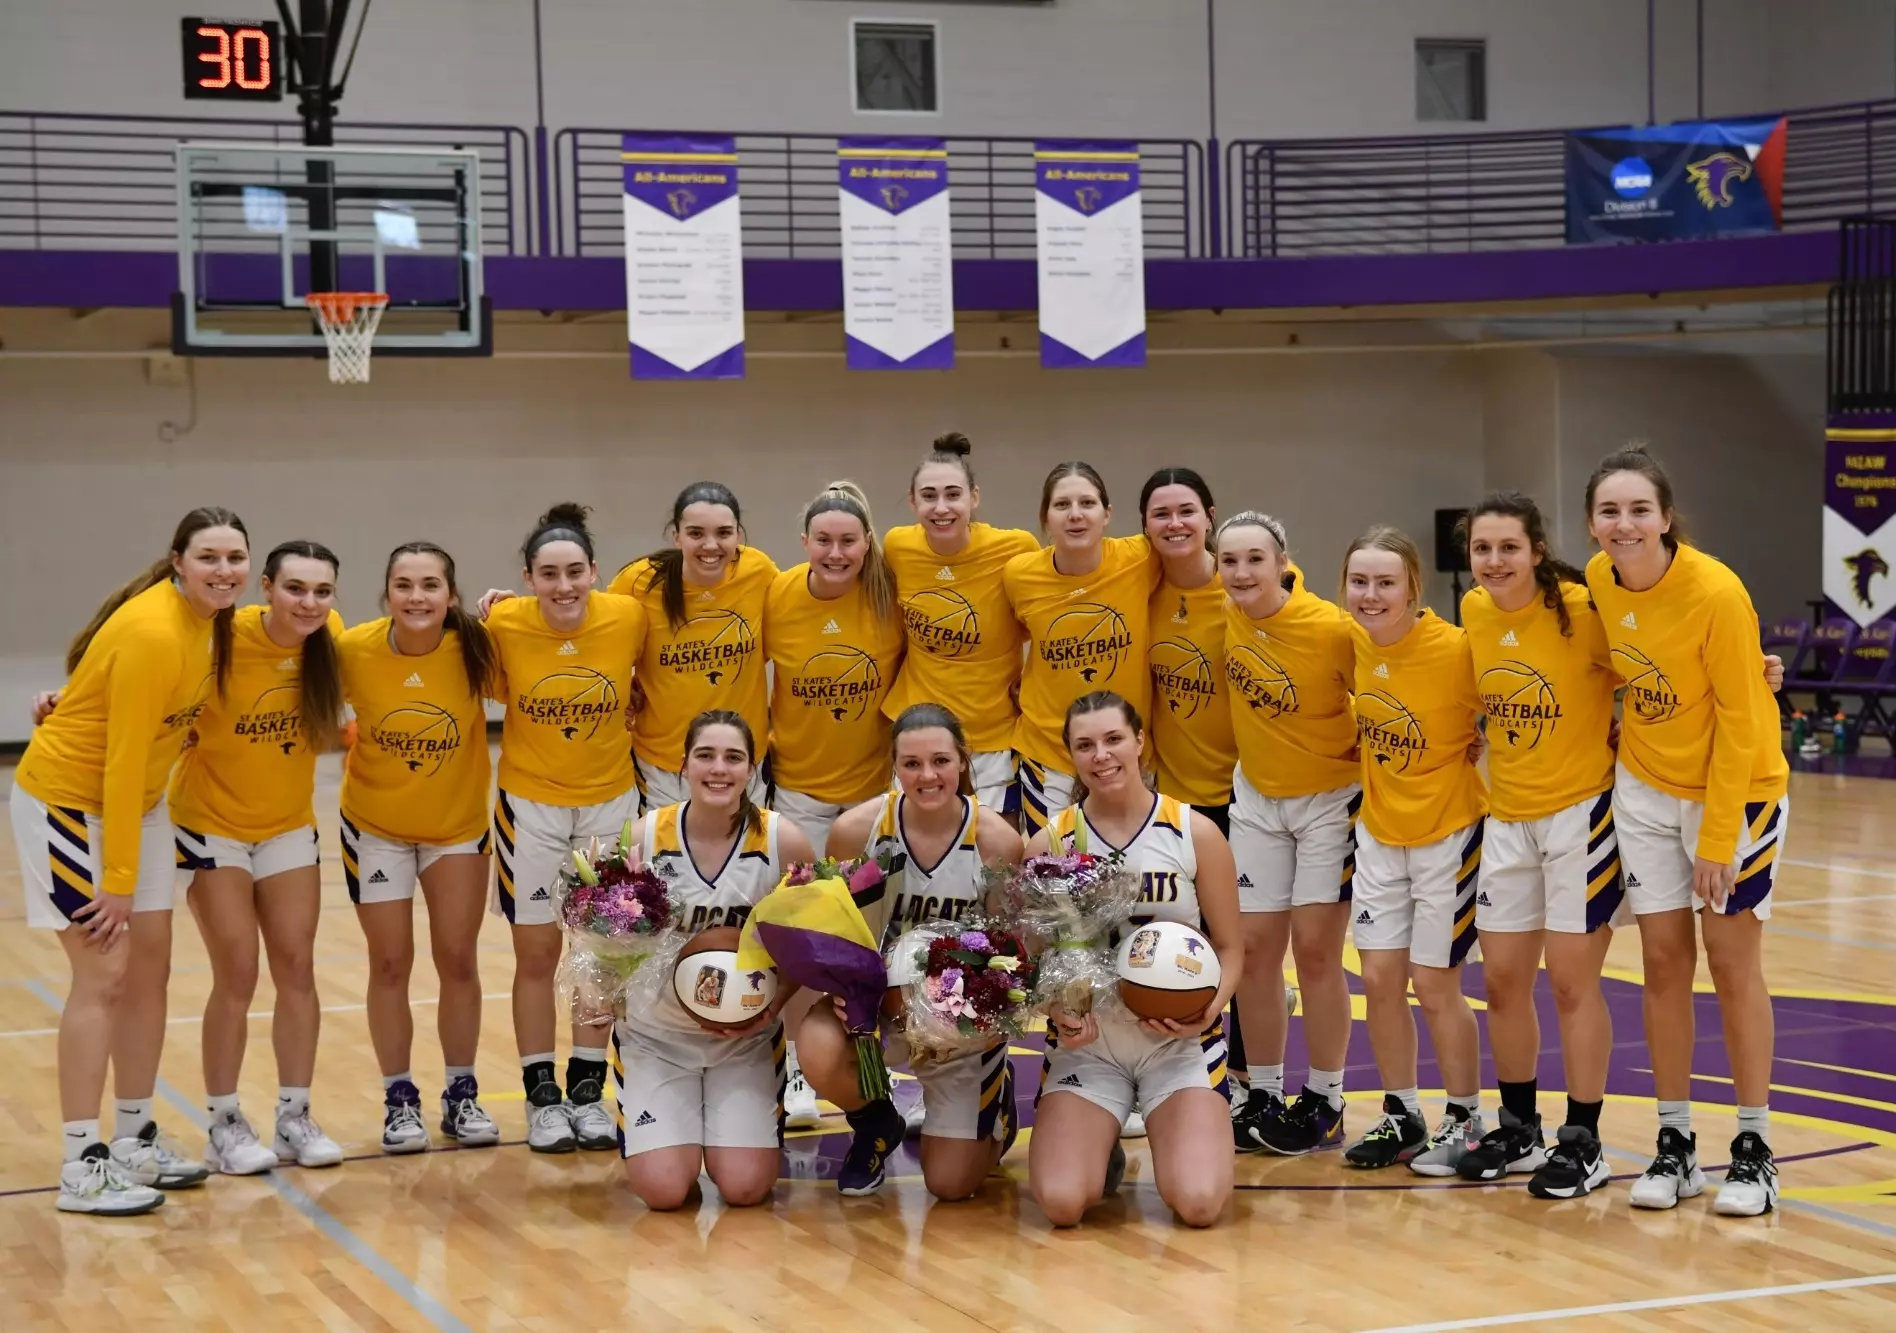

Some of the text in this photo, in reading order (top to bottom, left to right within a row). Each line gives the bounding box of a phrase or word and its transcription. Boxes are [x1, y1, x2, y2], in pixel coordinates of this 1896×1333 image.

[197, 28, 270, 89] 30
[634, 172, 727, 184] All-Americans
[849, 167, 938, 180] All-Americans
[1044, 168, 1130, 182] All-Americans
[905, 612, 981, 645] ASKETBALL
[676, 640, 705, 651] KATE'S
[1040, 632, 1132, 661] BASKETBALL
[1050, 636, 1078, 647] KATE'S
[660, 638, 757, 666] BASKETBALL
[675, 657, 738, 674] WILDCATS
[1052, 654, 1113, 670] WILDCATS
[791, 676, 882, 698] BASKETBALL
[804, 676, 831, 685] KATE'S
[1159, 673, 1216, 695] KETBALL
[1225, 661, 1300, 713] ASKETBALL
[532, 697, 563, 706] KATE'S
[803, 695, 864, 707] WILDCATS
[1165, 688, 1195, 701] DCATS
[255, 711, 284, 721] KATE'S
[518, 699, 620, 718] BASKETBALL
[1486, 703, 1563, 719] SKETBALL
[234, 716, 301, 735] BASKET
[530, 715, 596, 725] WILDCATS
[371, 732, 461, 753] BASKETBALL
[1364, 724, 1429, 750] KETBALL
[381, 746, 442, 761] WILDCATS
[1369, 741, 1405, 757] DCATS
